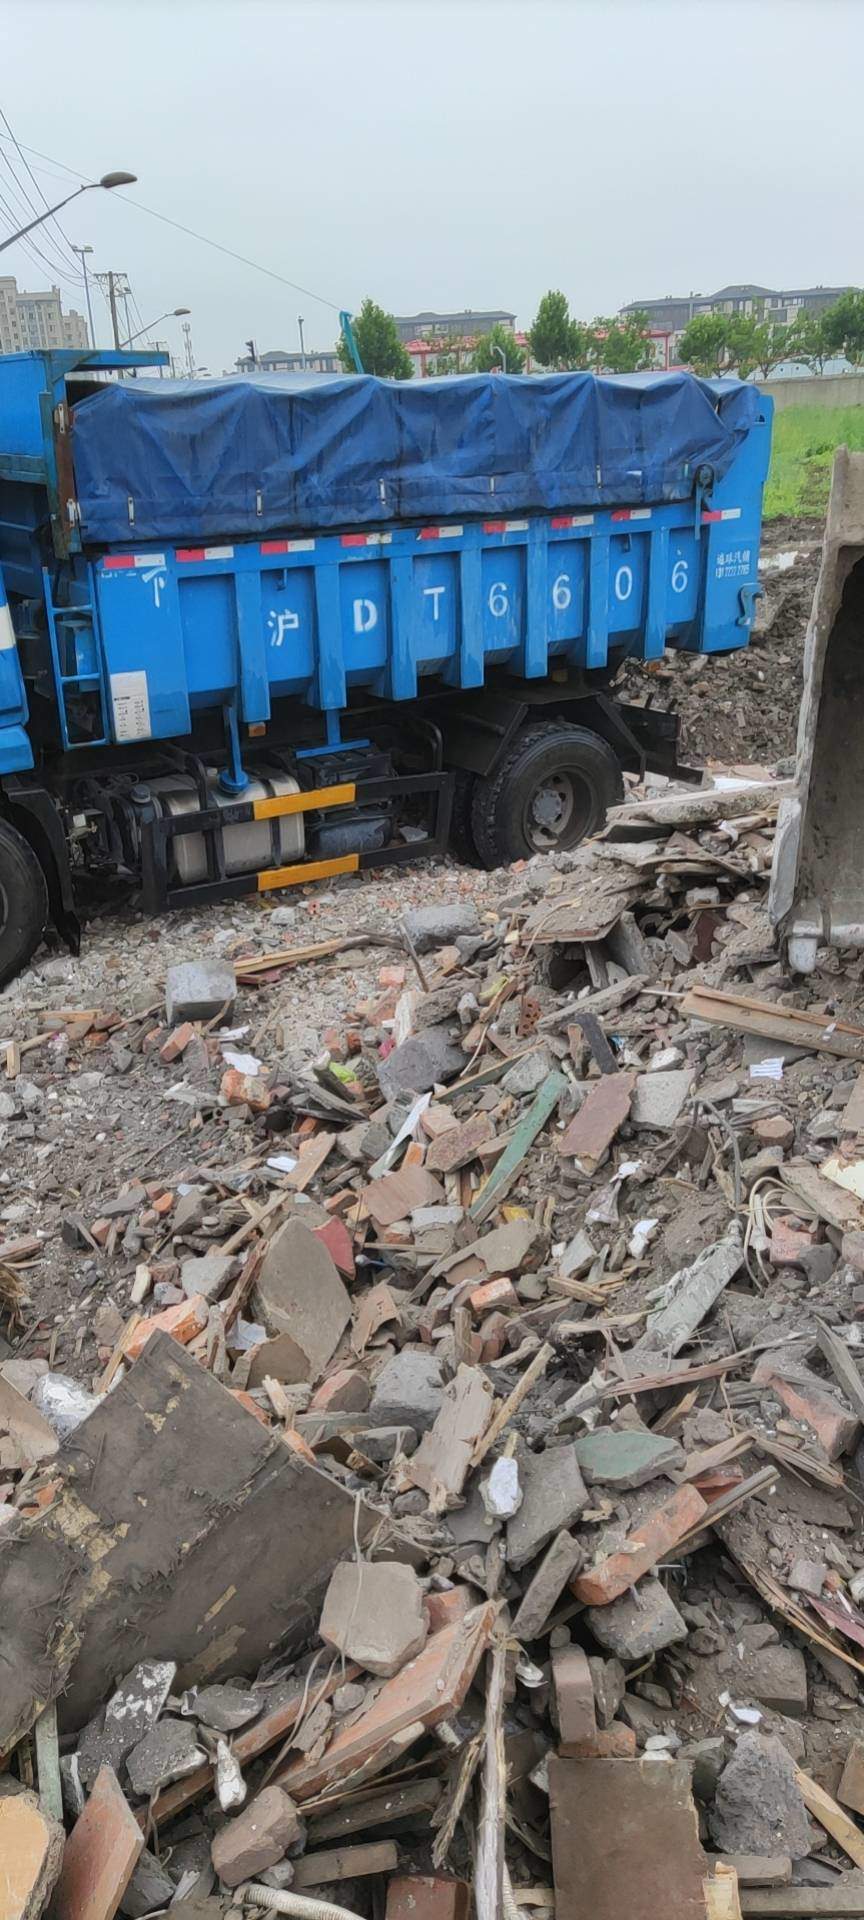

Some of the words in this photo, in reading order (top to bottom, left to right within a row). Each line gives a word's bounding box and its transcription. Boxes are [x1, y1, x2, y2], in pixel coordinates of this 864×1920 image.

[267, 609, 299, 647] 沪
[353, 599, 378, 632] D
[423, 586, 446, 620] T
[488, 582, 509, 617] 6
[552, 574, 572, 610] 6
[614, 566, 633, 601] 0
[671, 560, 689, 593] 6
